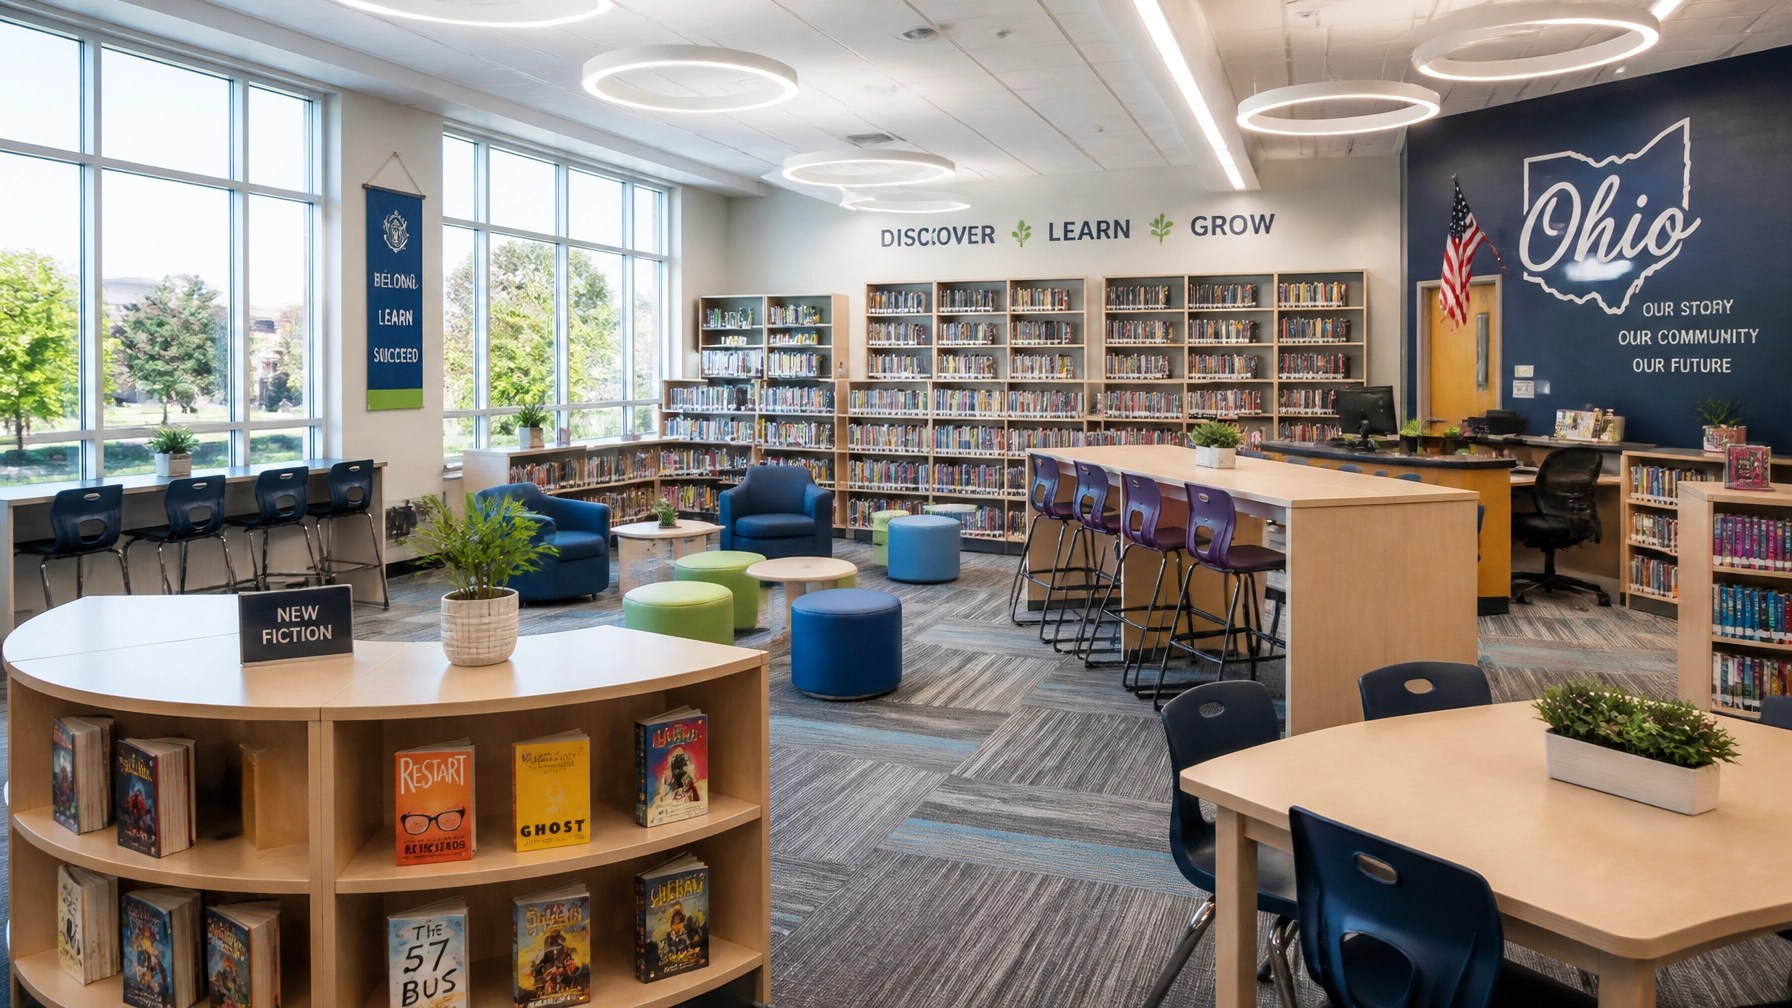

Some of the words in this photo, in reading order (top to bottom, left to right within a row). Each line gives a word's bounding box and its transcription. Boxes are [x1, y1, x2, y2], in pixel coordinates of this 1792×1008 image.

[1048, 219, 1131, 242] LEARN
[1190, 213, 1276, 237] GROW
[1519, 175, 1701, 272] Ohio
[378, 308, 413, 326] LEARN
[1642, 302, 1674, 317] OUR
[1680, 299, 1734, 316] STORY
[1618, 330, 1652, 346] OUR
[1658, 328, 1759, 345] COMMUNITY
[1632, 358, 1665, 373] OUR
[1671, 358, 1732, 373] FUTURE
[277, 605, 319, 623] NEW
[262, 624, 332, 645] FICTION
[400, 755, 467, 795] RESTART
[520, 819, 586, 837] GHOST
[403, 938, 450, 974] 57
[402, 968, 457, 1007] BUS
